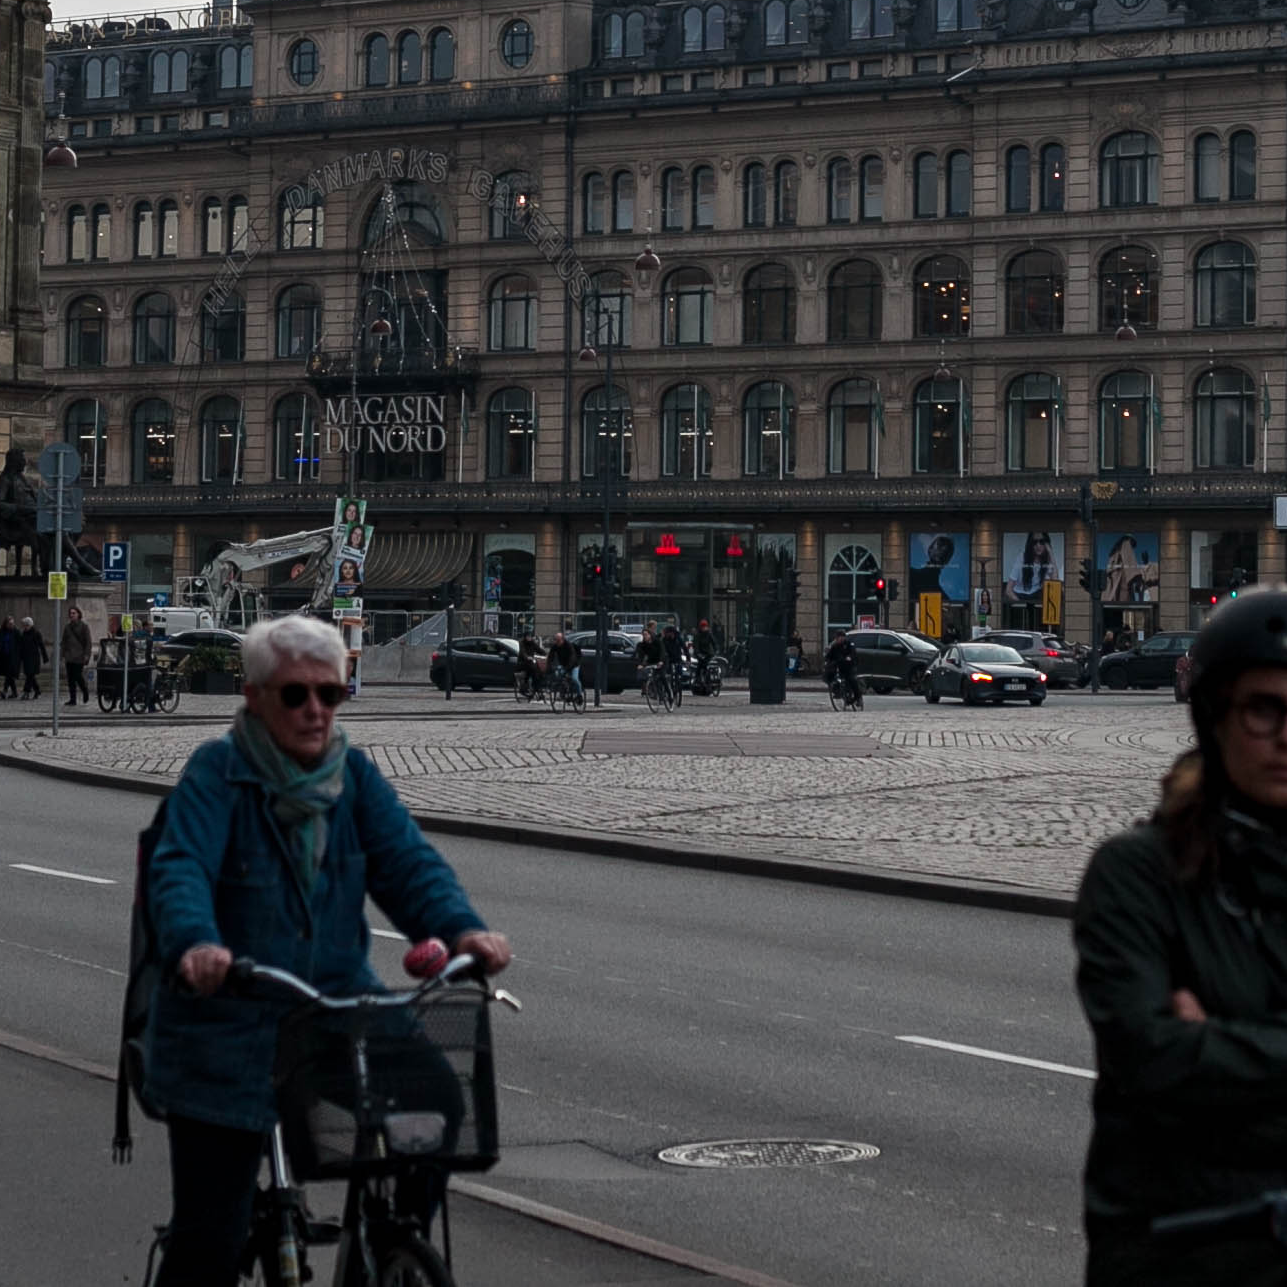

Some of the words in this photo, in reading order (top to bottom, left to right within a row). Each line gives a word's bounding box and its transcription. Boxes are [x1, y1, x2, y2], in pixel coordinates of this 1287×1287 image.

[285, 147, 448, 216] DANMARKS
[324, 395, 446, 425] MAGASIN
[326, 426, 362, 453] DU
[367, 424, 446, 453] NORD
[109, 545, 123, 568] P
